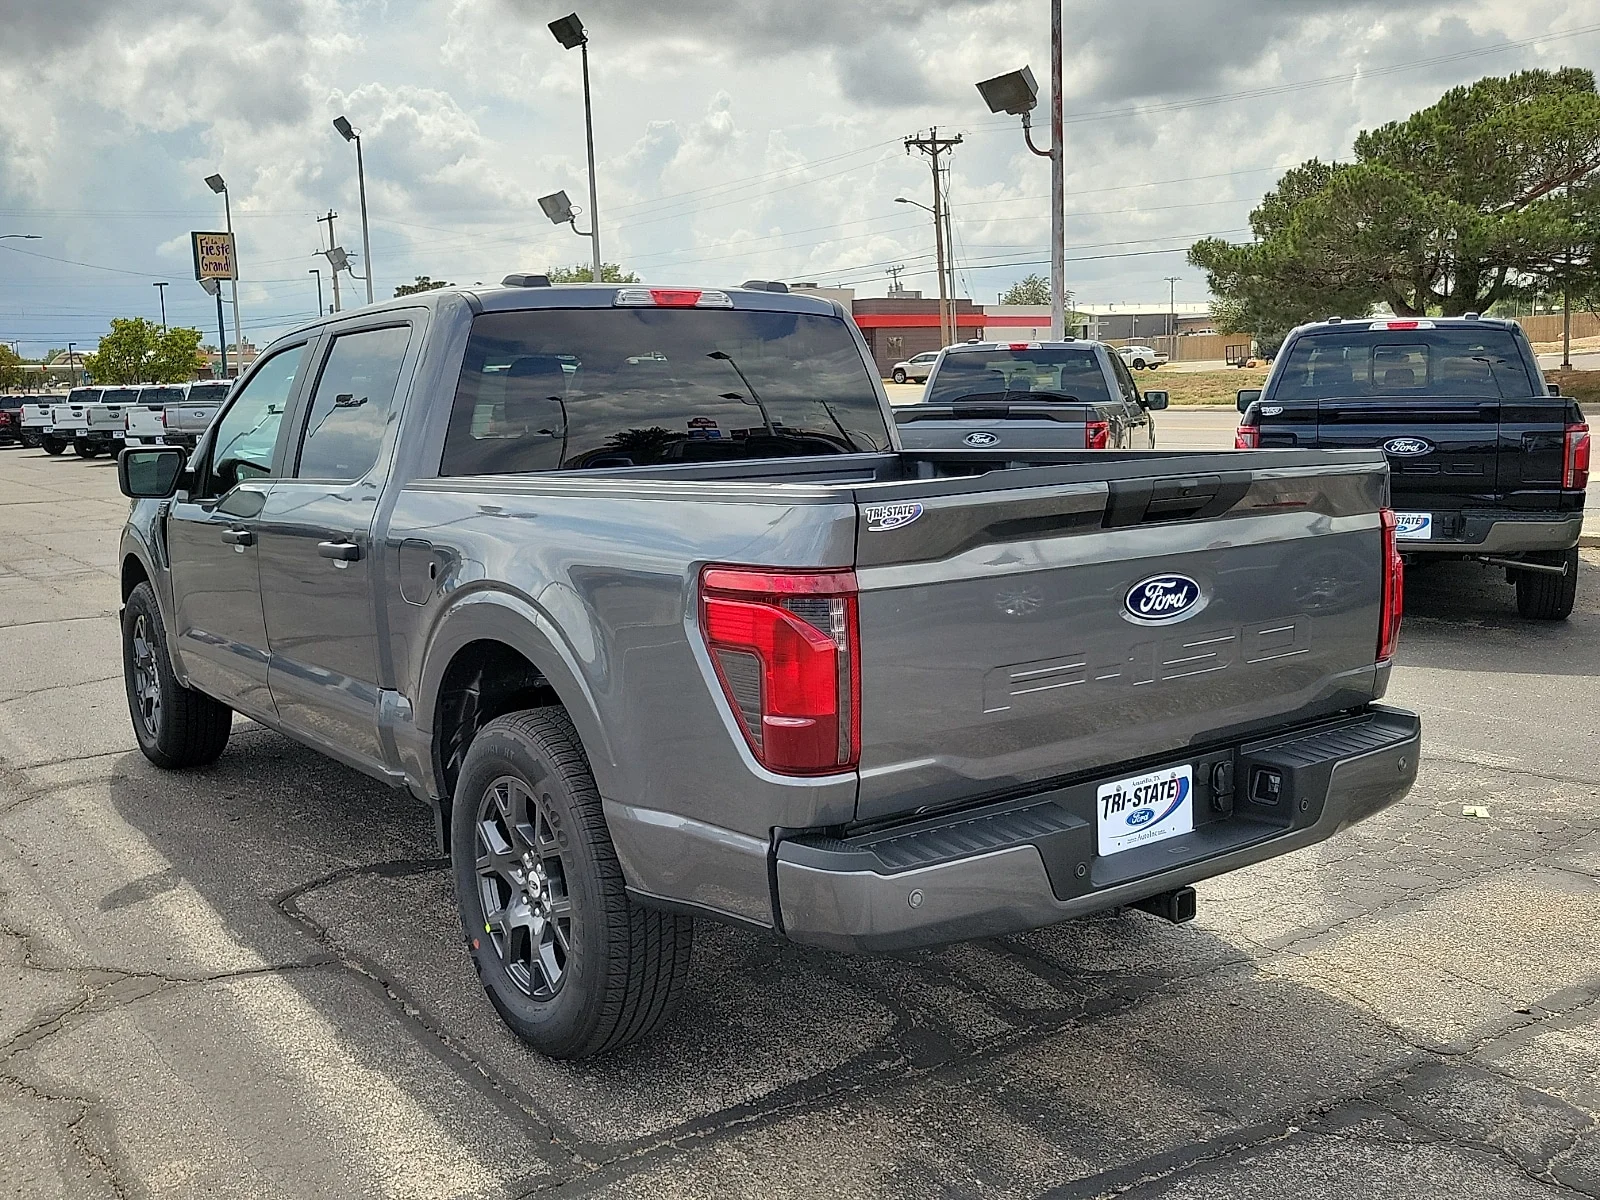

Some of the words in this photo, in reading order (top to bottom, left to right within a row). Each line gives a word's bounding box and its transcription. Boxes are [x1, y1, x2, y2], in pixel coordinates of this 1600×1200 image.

[201, 256, 230, 272] Grand
[971, 434, 991, 443] Ford
[1390, 440, 1420, 452] Ford
[867, 505, 914, 522] TRI-STATE
[1395, 516, 1421, 525] STATE
[1140, 581, 1189, 613] Ford
[983, 613, 1312, 713] F-150
[1101, 779, 1177, 821] TRI-STATE
[1131, 811, 1150, 824] Ford
